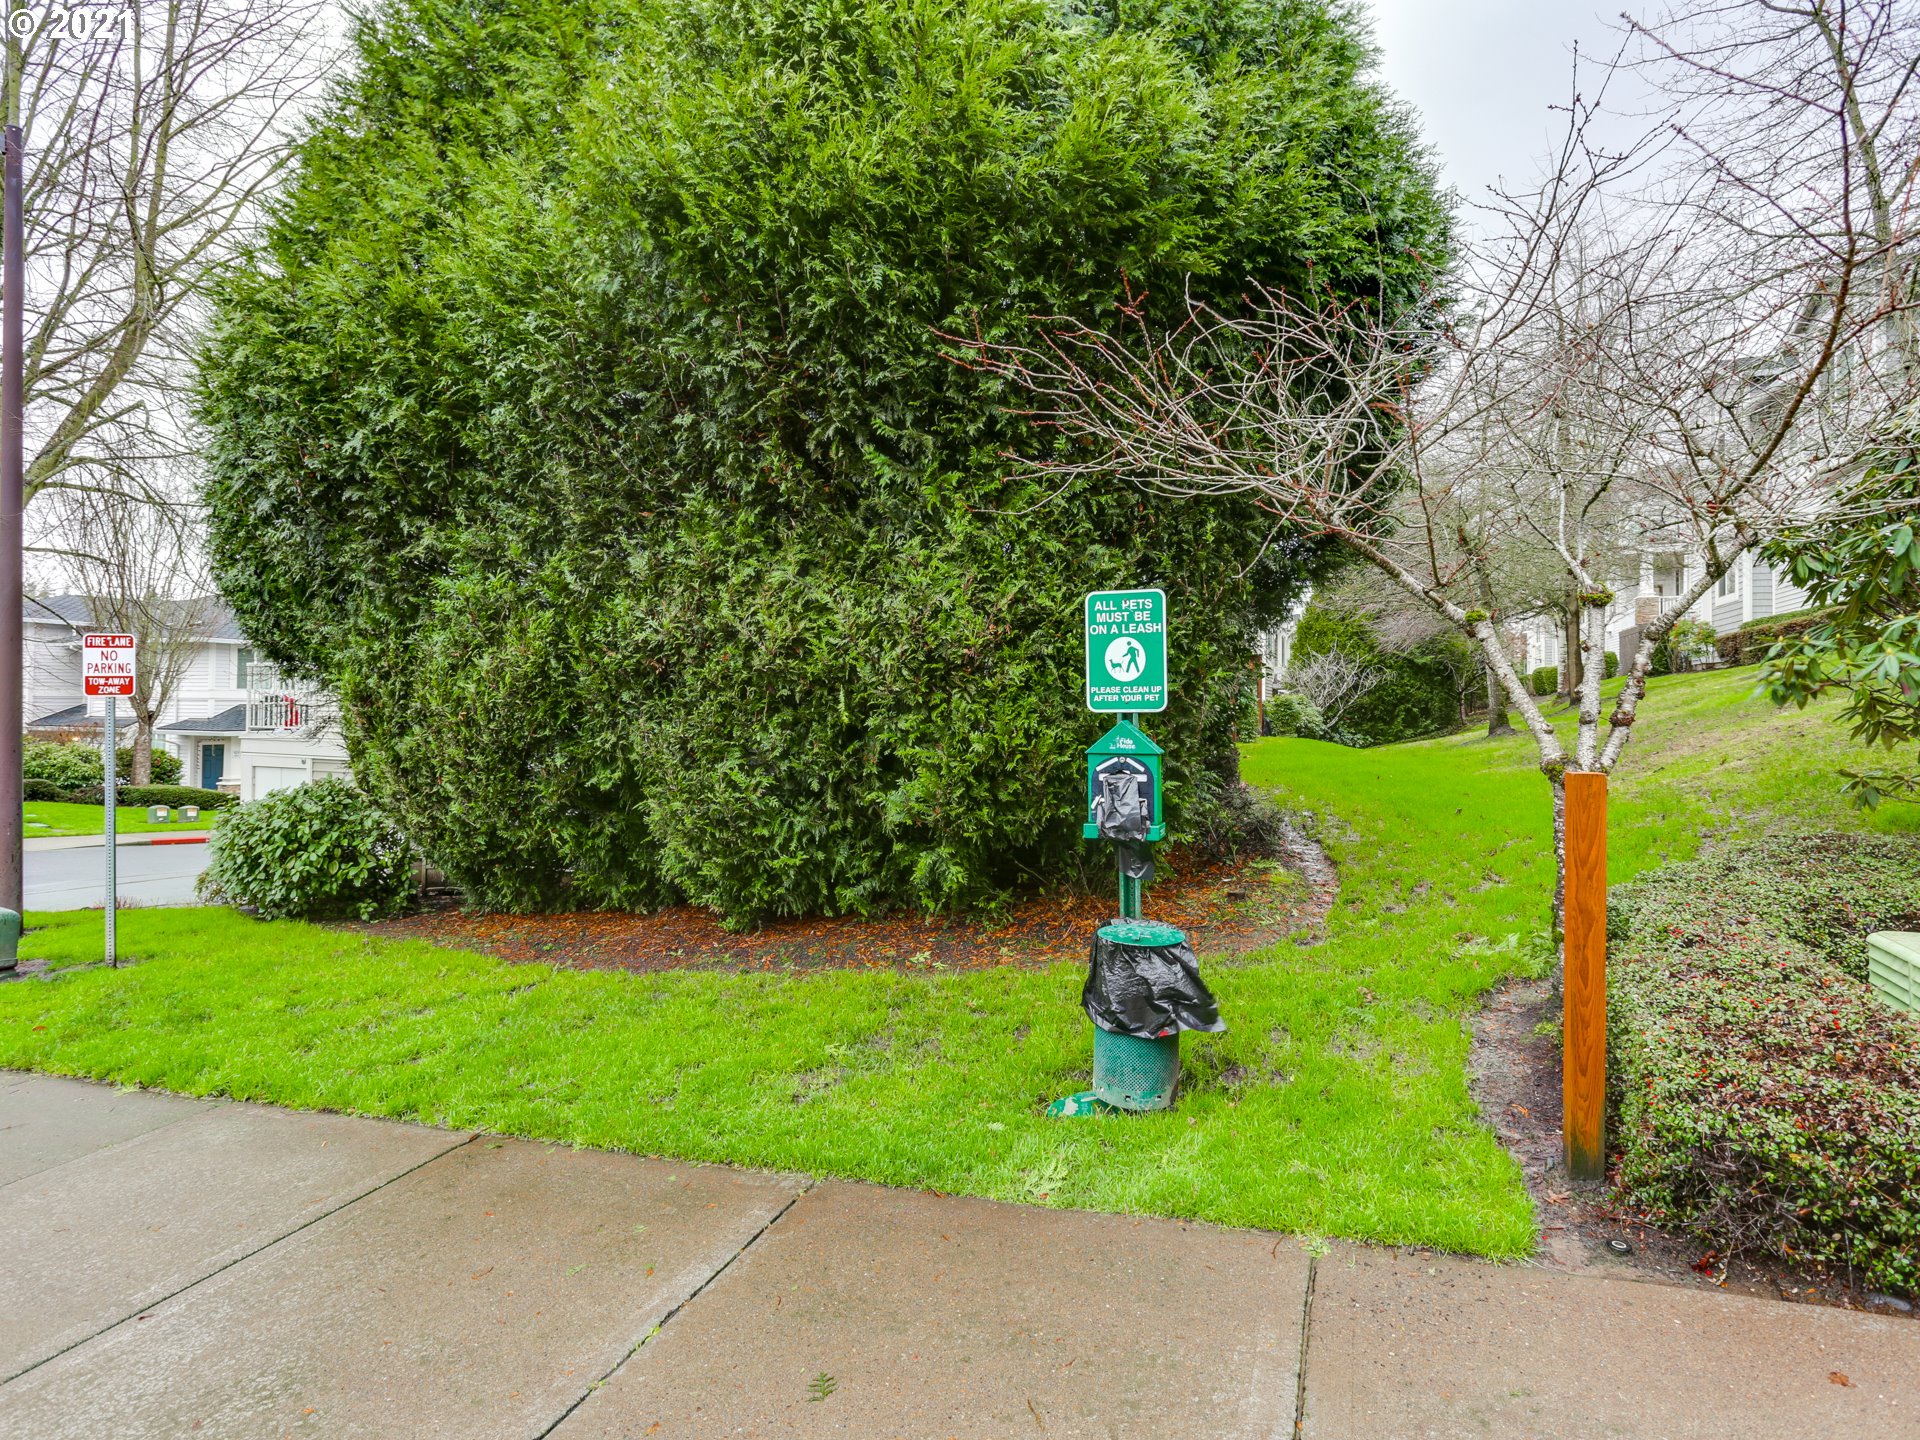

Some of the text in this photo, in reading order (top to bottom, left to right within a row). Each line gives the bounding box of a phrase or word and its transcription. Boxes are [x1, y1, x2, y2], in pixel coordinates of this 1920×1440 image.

[1094, 599, 1152, 611] ALL PETS
[1096, 611, 1151, 622] MUST BE
[1090, 623, 1161, 634] ON A LEASH
[87, 637, 131, 646] FIRE LANE
[101, 650, 118, 661] NO
[88, 663, 131, 673] PARKING
